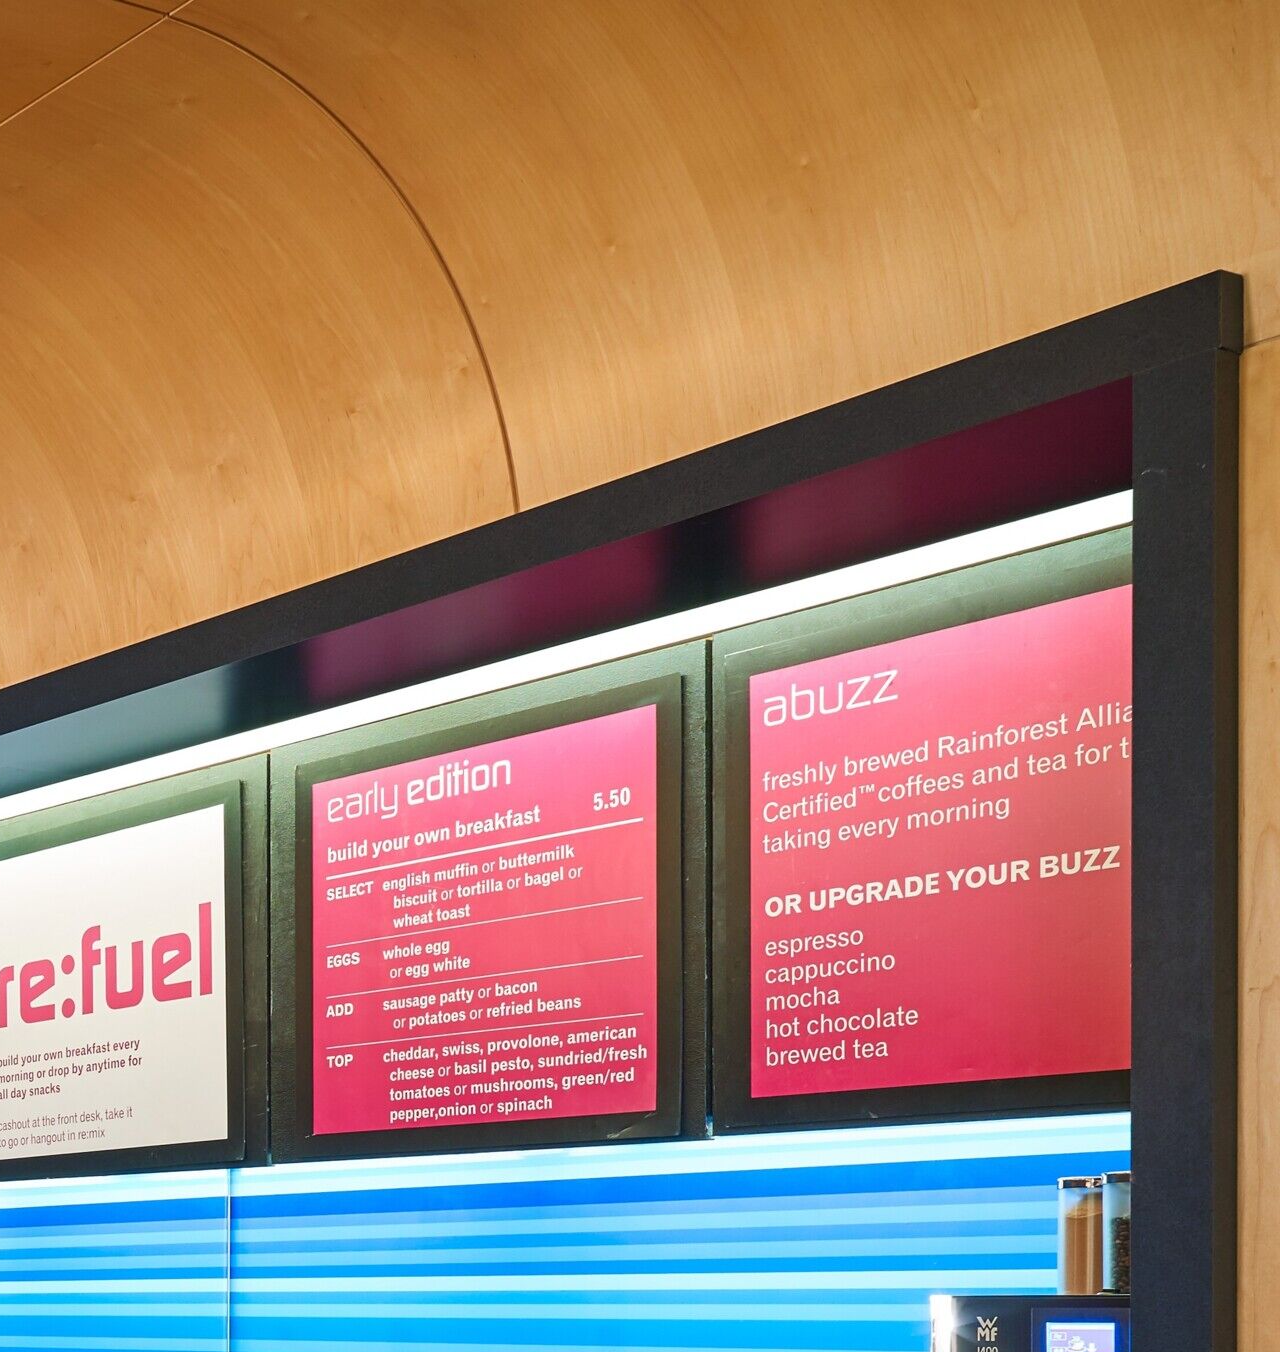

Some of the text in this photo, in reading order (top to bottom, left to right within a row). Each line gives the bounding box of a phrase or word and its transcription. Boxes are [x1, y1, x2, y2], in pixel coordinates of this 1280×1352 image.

[764, 670, 898, 726] abuzz
[763, 761, 837, 791] freshly
[844, 740, 928, 776] brewed
[938, 715, 1068, 758] Rainforest
[878, 773, 964, 802] coffees
[972, 759, 1018, 785] and
[1027, 754, 1067, 775] tea
[1075, 745, 1112, 766] for
[328, 760, 511, 822] early edition
[328, 787, 630, 863] build your own breakfast 5.50
[763, 798, 1009, 853] taking every morning
[327, 846, 574, 901] SELECT english muffin or buttermilk
[394, 867, 583, 908] biscuit or tortilla or bagel or
[765, 846, 1120, 917] OR UPGRADE YOUR BUZZ
[393, 904, 470, 928] wheat toast
[327, 941, 449, 968] EGGS whole egg
[765, 930, 863, 957] espresso
[390, 956, 470, 978] or egg white
[766, 955, 895, 985] cappuccino
[326, 982, 537, 1017] ADD sausage patty or bacon
[394, 998, 581, 1029] or potatoes or refried beans
[767, 986, 840, 1011] mocha
[767, 1006, 918, 1038] hot chocolate
[21, 1054, 41, 1067] your
[44, 1051, 62, 1061] own
[66, 1042, 110, 1057] breakfast
[113, 1040, 140, 1051] every
[327, 1027, 636, 1068] TOP cheddar, swiss, provolone, american
[390, 1045, 647, 1081] cheese or basil pesto, sundried/fresh
[767, 1040, 888, 1066] brewed tea
[48, 1066, 69, 1077] drop
[72, 1063, 83, 1076] by
[86, 1058, 125, 1073] anytime
[128, 1055, 142, 1066] for
[11, 1088, 26, 1099] day
[30, 1083, 60, 1096] snacks
[390, 1067, 634, 1101] tomatoes or mushrooms, green/red
[32, 1117, 40, 1127] at
[42, 1116, 55, 1126] the
[58, 1113, 77, 1124] front
[80, 1110, 102, 1122] desk,
[105, 1108, 124, 1120] take
[127, 1107, 132, 1117] it
[390, 1095, 552, 1123] pepper,onion or spinach
[0, 1127, 105, 1149] to go or hangout in re:mix
